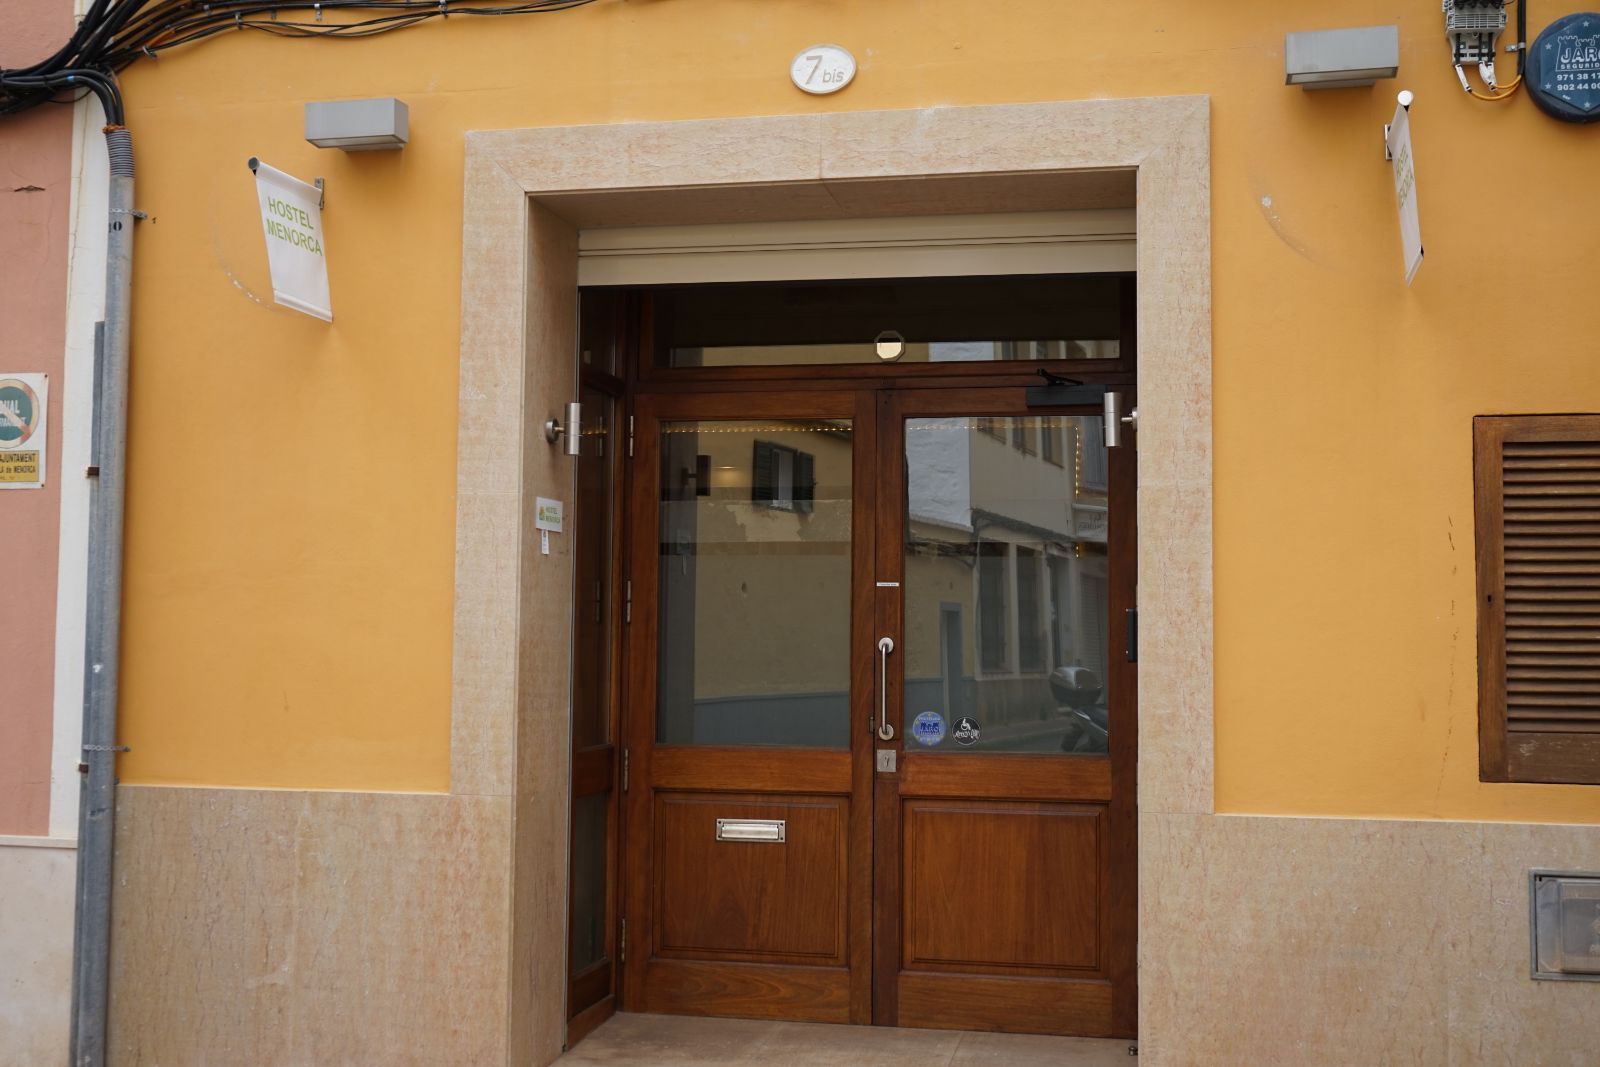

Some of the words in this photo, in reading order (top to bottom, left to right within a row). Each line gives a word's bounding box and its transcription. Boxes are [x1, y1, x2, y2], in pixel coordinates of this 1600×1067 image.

[805, 55, 823, 85] 7
[822, 69, 845, 83] bis
[1557, 83, 1575, 91] 902
[267, 196, 314, 230] HOSTEL
[266, 218, 323, 257] MENORCA
